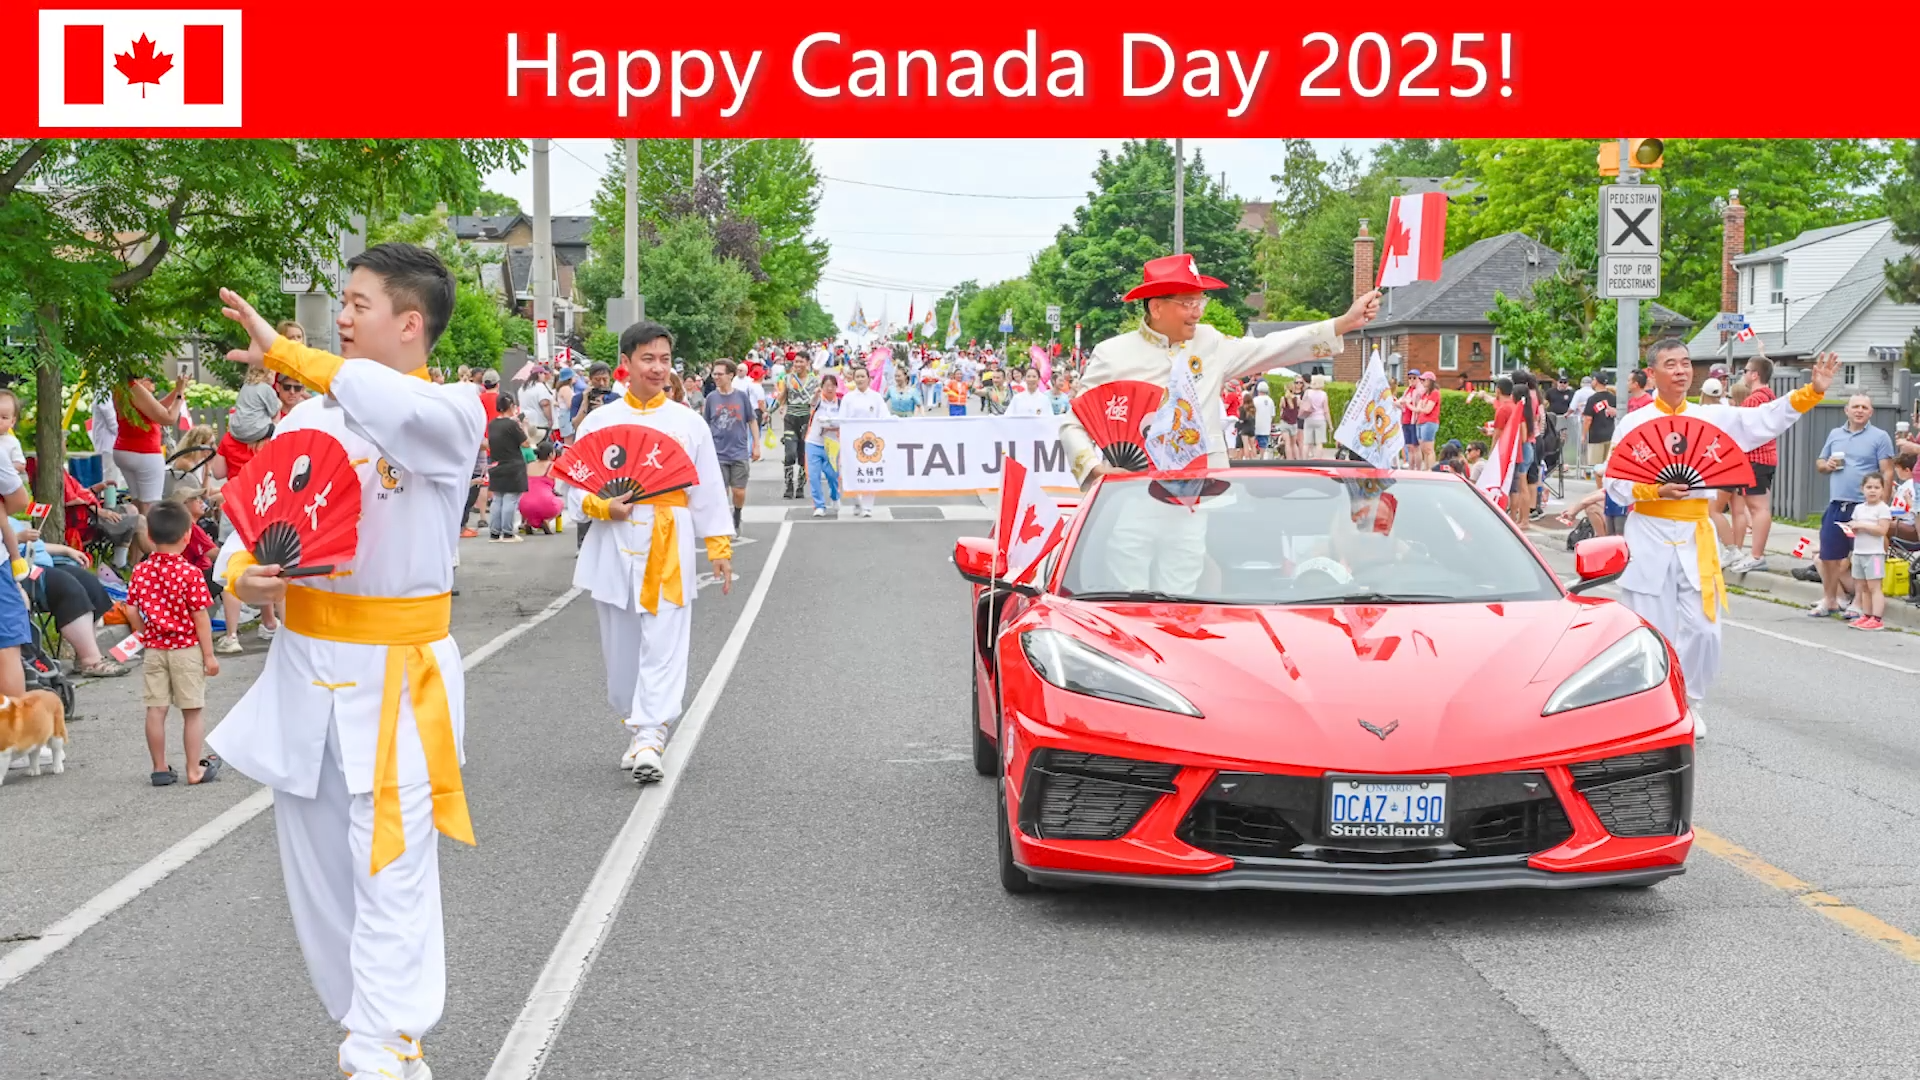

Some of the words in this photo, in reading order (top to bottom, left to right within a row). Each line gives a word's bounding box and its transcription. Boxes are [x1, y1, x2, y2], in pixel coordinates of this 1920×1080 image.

[1609, 193, 1657, 205] PEDESTRIAN
[1613, 264, 1633, 275] STOP
[1637, 264, 1652, 275] FOR
[1608, 278, 1657, 289] PEDESTRIANS
[896, 442, 966, 477] TAI
[1366, 784, 1413, 793] ONTARIO
[1333, 794, 1388, 822] DCAZ
[1403, 795, 1443, 823] 190
[1330, 823, 1445, 837] Strickland's
